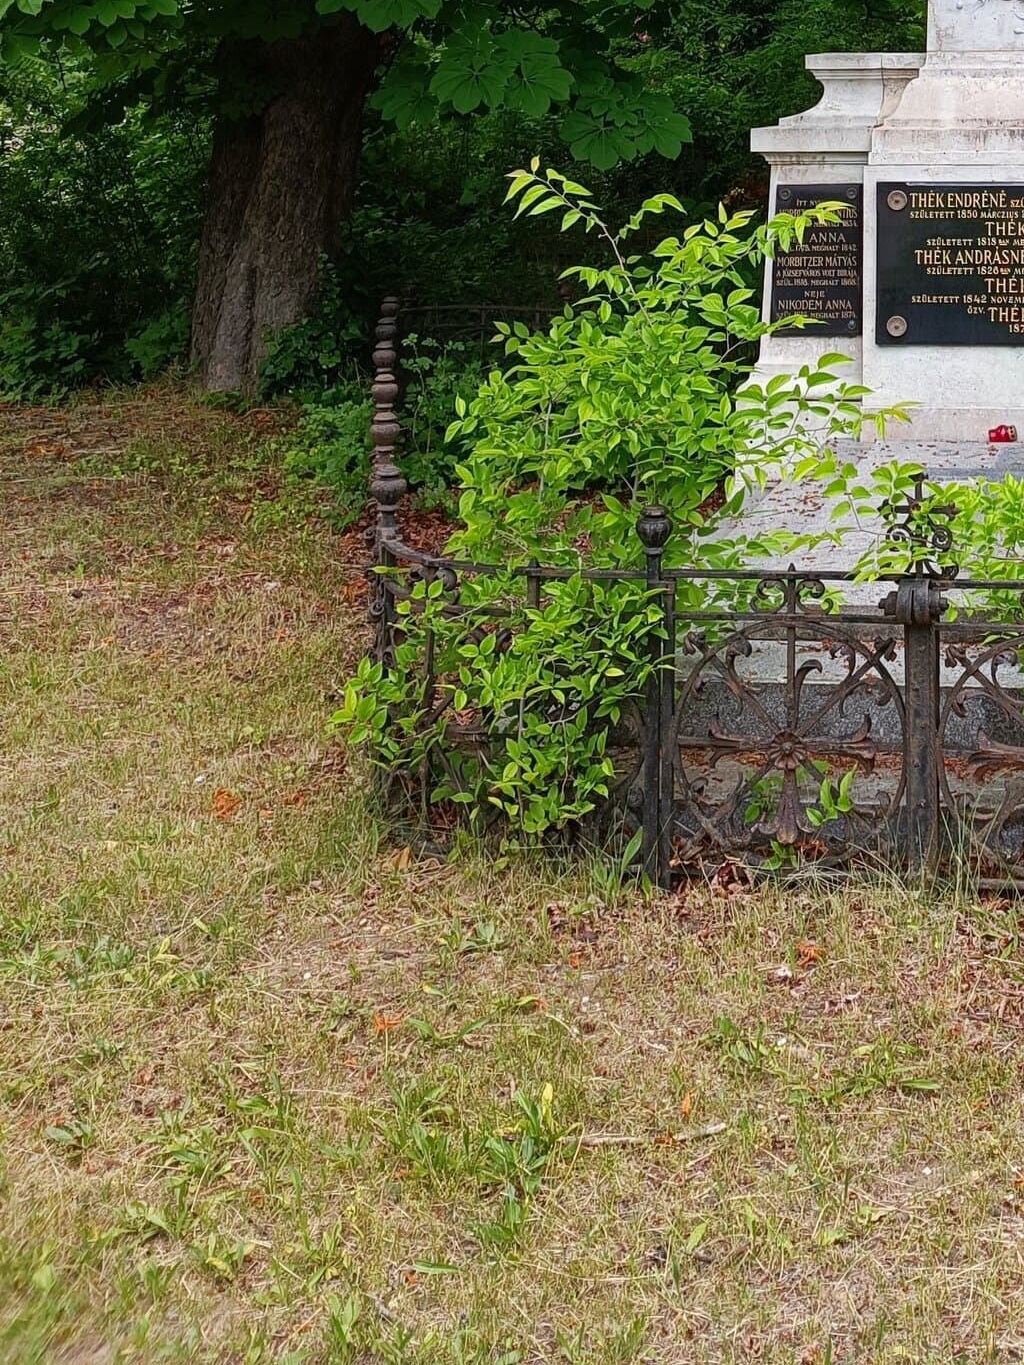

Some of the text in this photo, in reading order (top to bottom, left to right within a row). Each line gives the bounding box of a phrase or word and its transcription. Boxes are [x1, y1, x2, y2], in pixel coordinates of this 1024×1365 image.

[909, 189, 944, 208] THÉK
[947, 189, 1007, 209] ENDRÉNÉ
[909, 209, 955, 219] SZÜLETETT
[957, 209, 978, 219] 1850
[980, 209, 1018, 219] MÁRCZIUS
[809, 232, 846, 243] ANNA
[926, 237, 973, 246] SZÜLETETT
[777, 253, 857, 267] MORBITZER MÁTYÁS
[914, 246, 951, 265] THÉK
[776, 269, 781, 277] A
[926, 266, 975, 275] SZÜLETETT
[804, 290, 825, 299] NEJE
[911, 294, 960, 304] SZÜLETETT
[963, 294, 987, 304] 1842
[778, 299, 852, 310] NIKODEM ANNA
